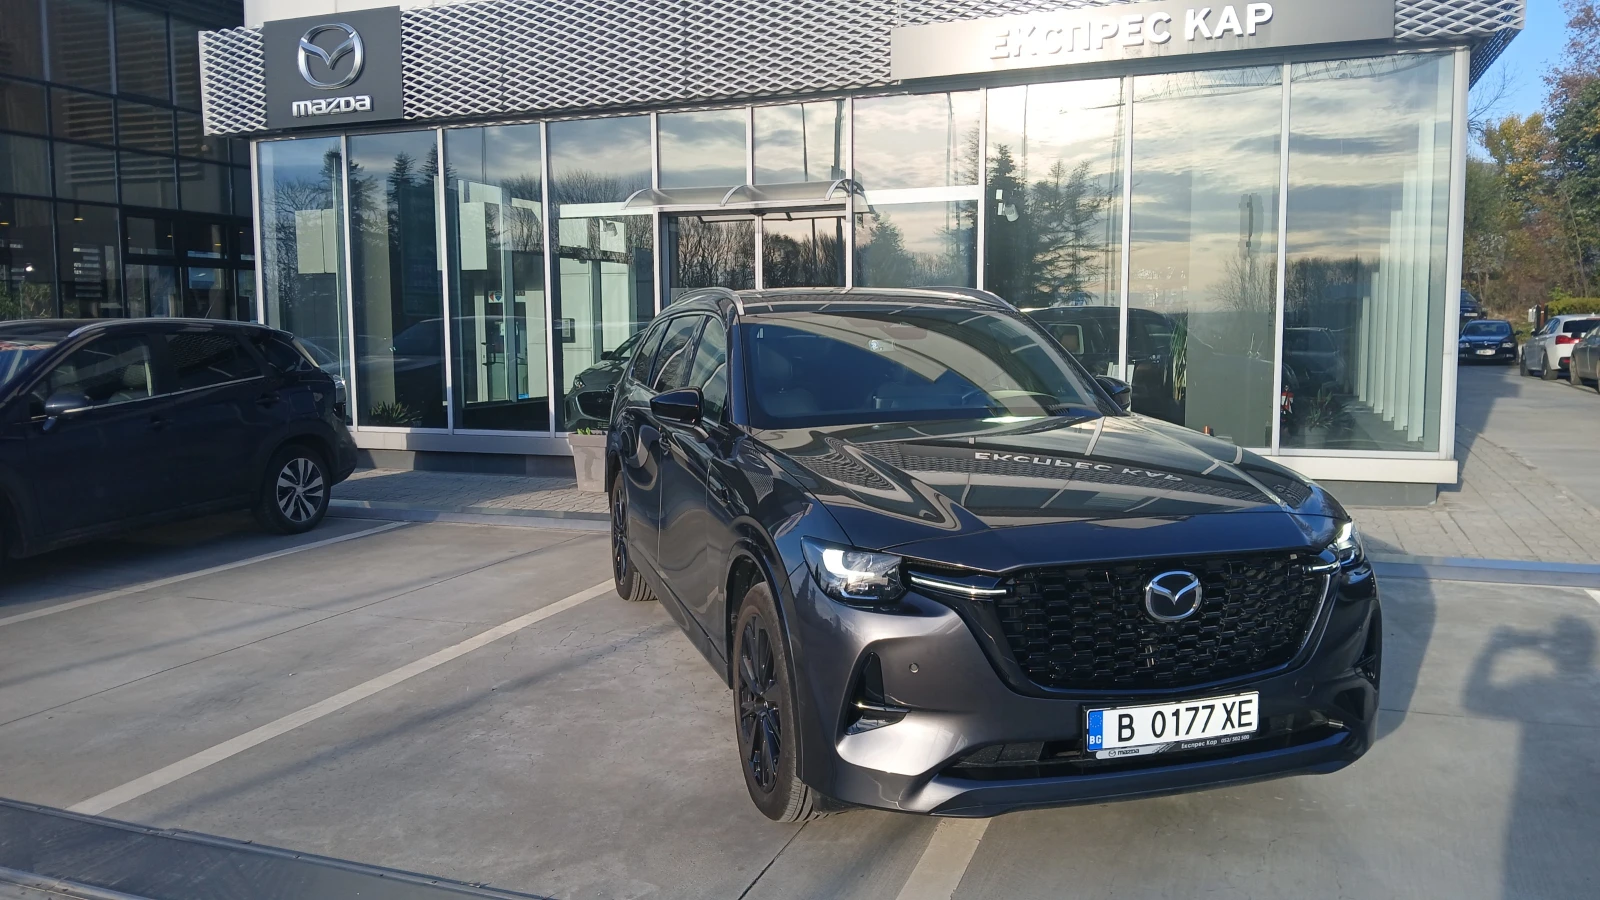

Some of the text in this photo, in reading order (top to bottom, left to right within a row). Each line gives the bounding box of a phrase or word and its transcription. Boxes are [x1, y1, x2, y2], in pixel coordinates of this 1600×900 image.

[990, 2, 1274, 60] ЕКСПРЕС КАР
[292, 95, 373, 117] mazda
[1117, 699, 1253, 743] B 0177 XE
[1089, 735, 1102, 745] BG
[1181, 741, 1206, 749] Експрес
